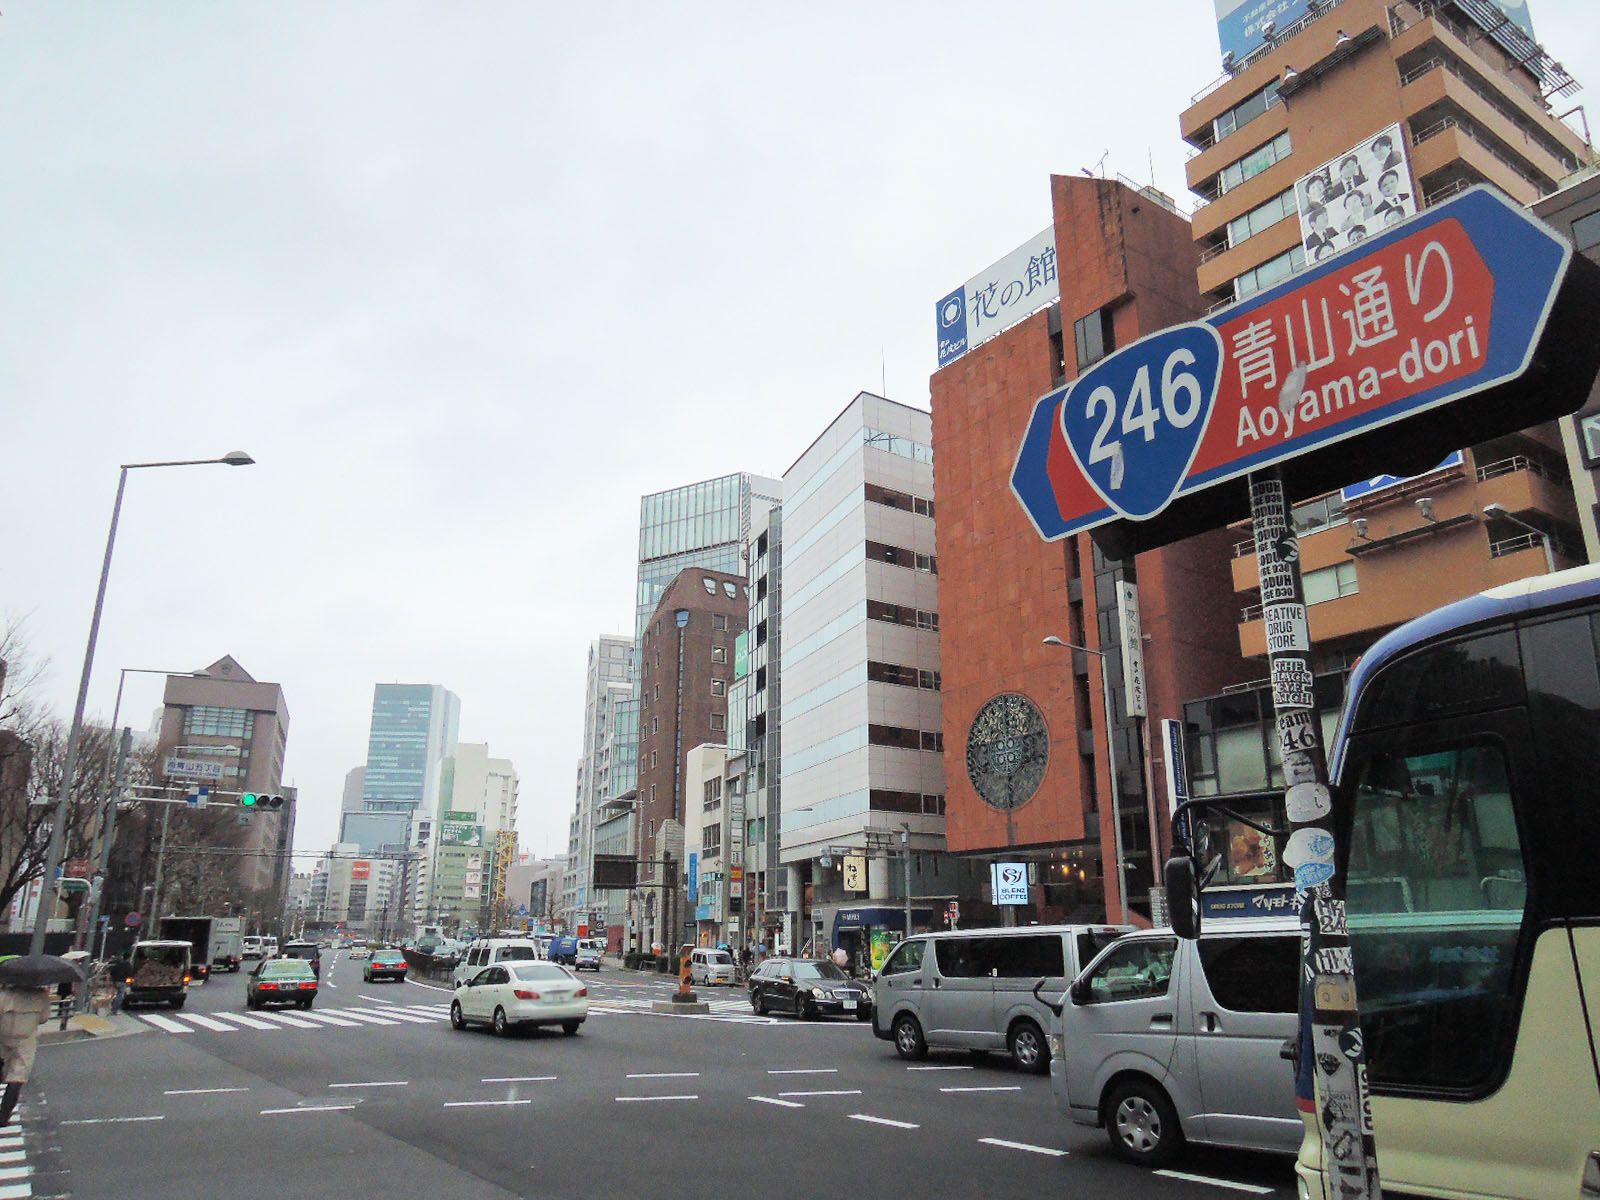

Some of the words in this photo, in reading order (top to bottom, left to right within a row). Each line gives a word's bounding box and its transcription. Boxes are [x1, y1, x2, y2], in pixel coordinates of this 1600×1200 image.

[969, 246, 1056, 328] 花の館
[1232, 241, 1454, 399] 青山通り
[1237, 315, 1480, 447] Aoyama-dori
[1086, 348, 1202, 465] 246
[1269, 620, 1293, 636] DRUG
[1269, 635, 1297, 650] STORE
[1275, 661, 1304, 672] THE
[1279, 727, 1316, 751] 46
[1000, 893, 1027, 901] COFFEE
